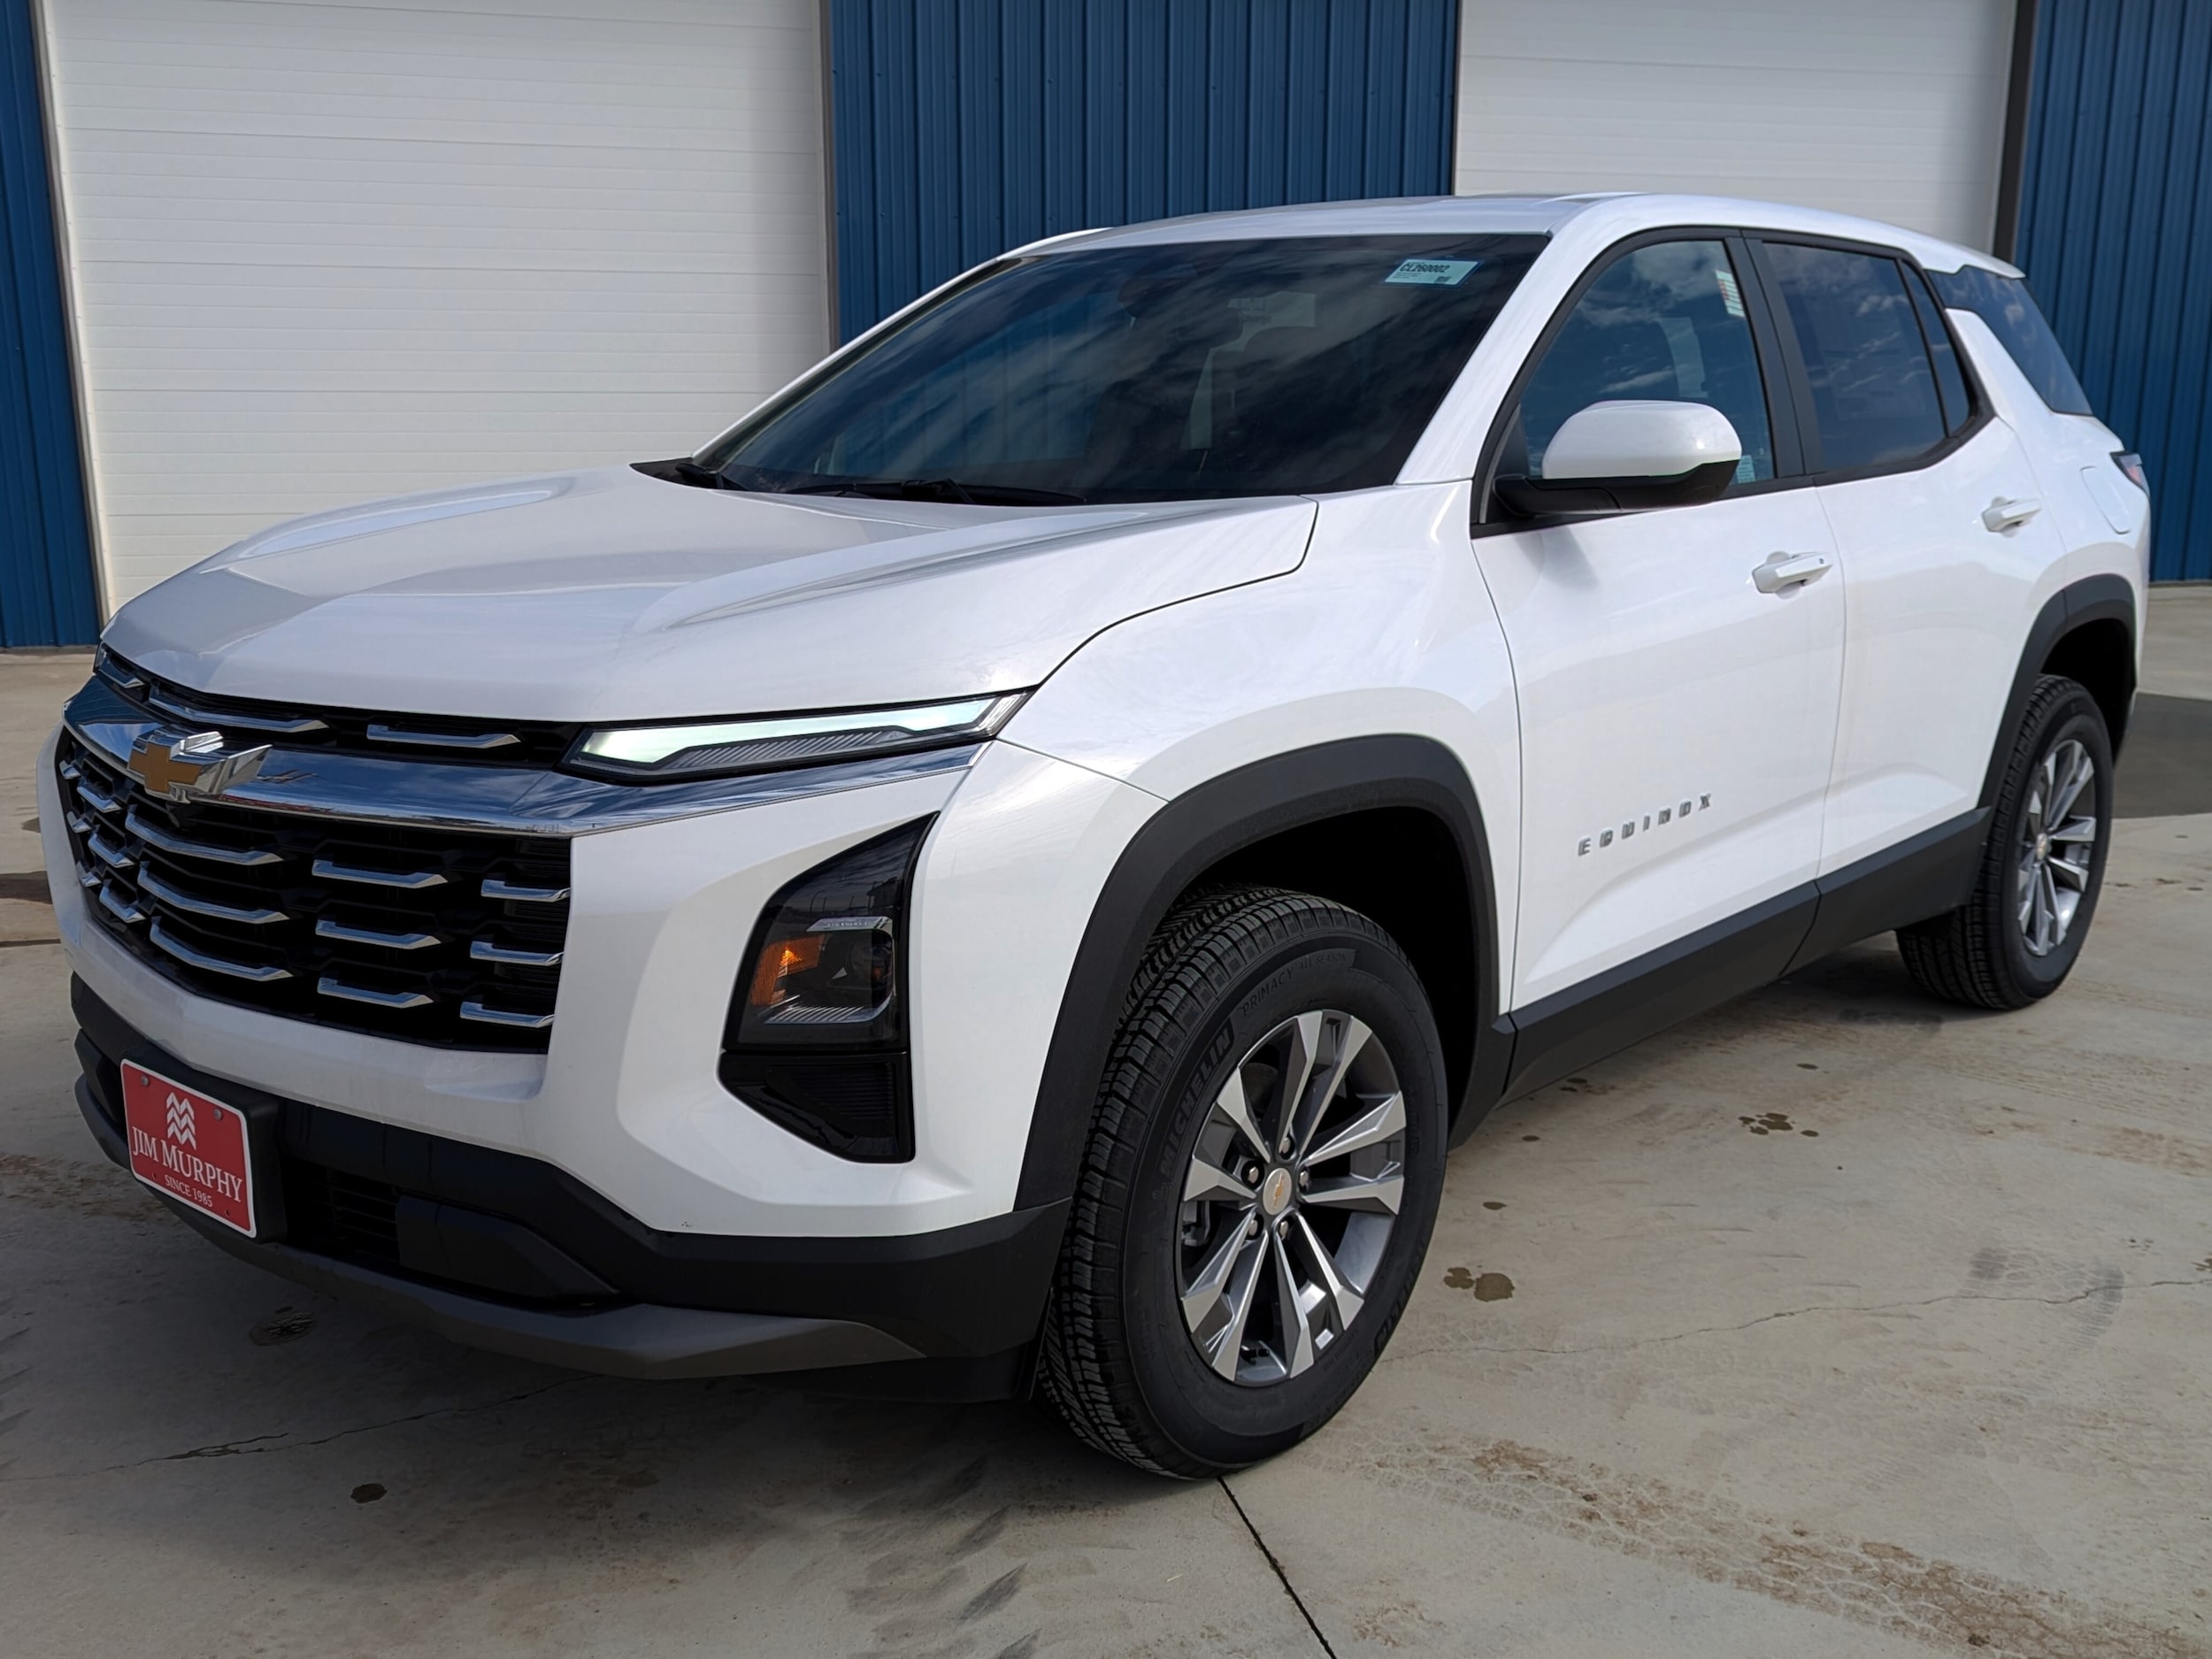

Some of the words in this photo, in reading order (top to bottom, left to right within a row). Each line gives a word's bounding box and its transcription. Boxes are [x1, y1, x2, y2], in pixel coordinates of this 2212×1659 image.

[1578, 793, 1711, 856] EQUINOX
[1241, 967, 1293, 1018] PRIMACY
[1160, 1025, 1234, 1178] MICHELIN
[133, 1126, 158, 1164] JIM
[160, 1139, 242, 1202] MURPHY
[164, 1174, 191, 1198] SINCE
[193, 1187, 213, 1208] 1985
